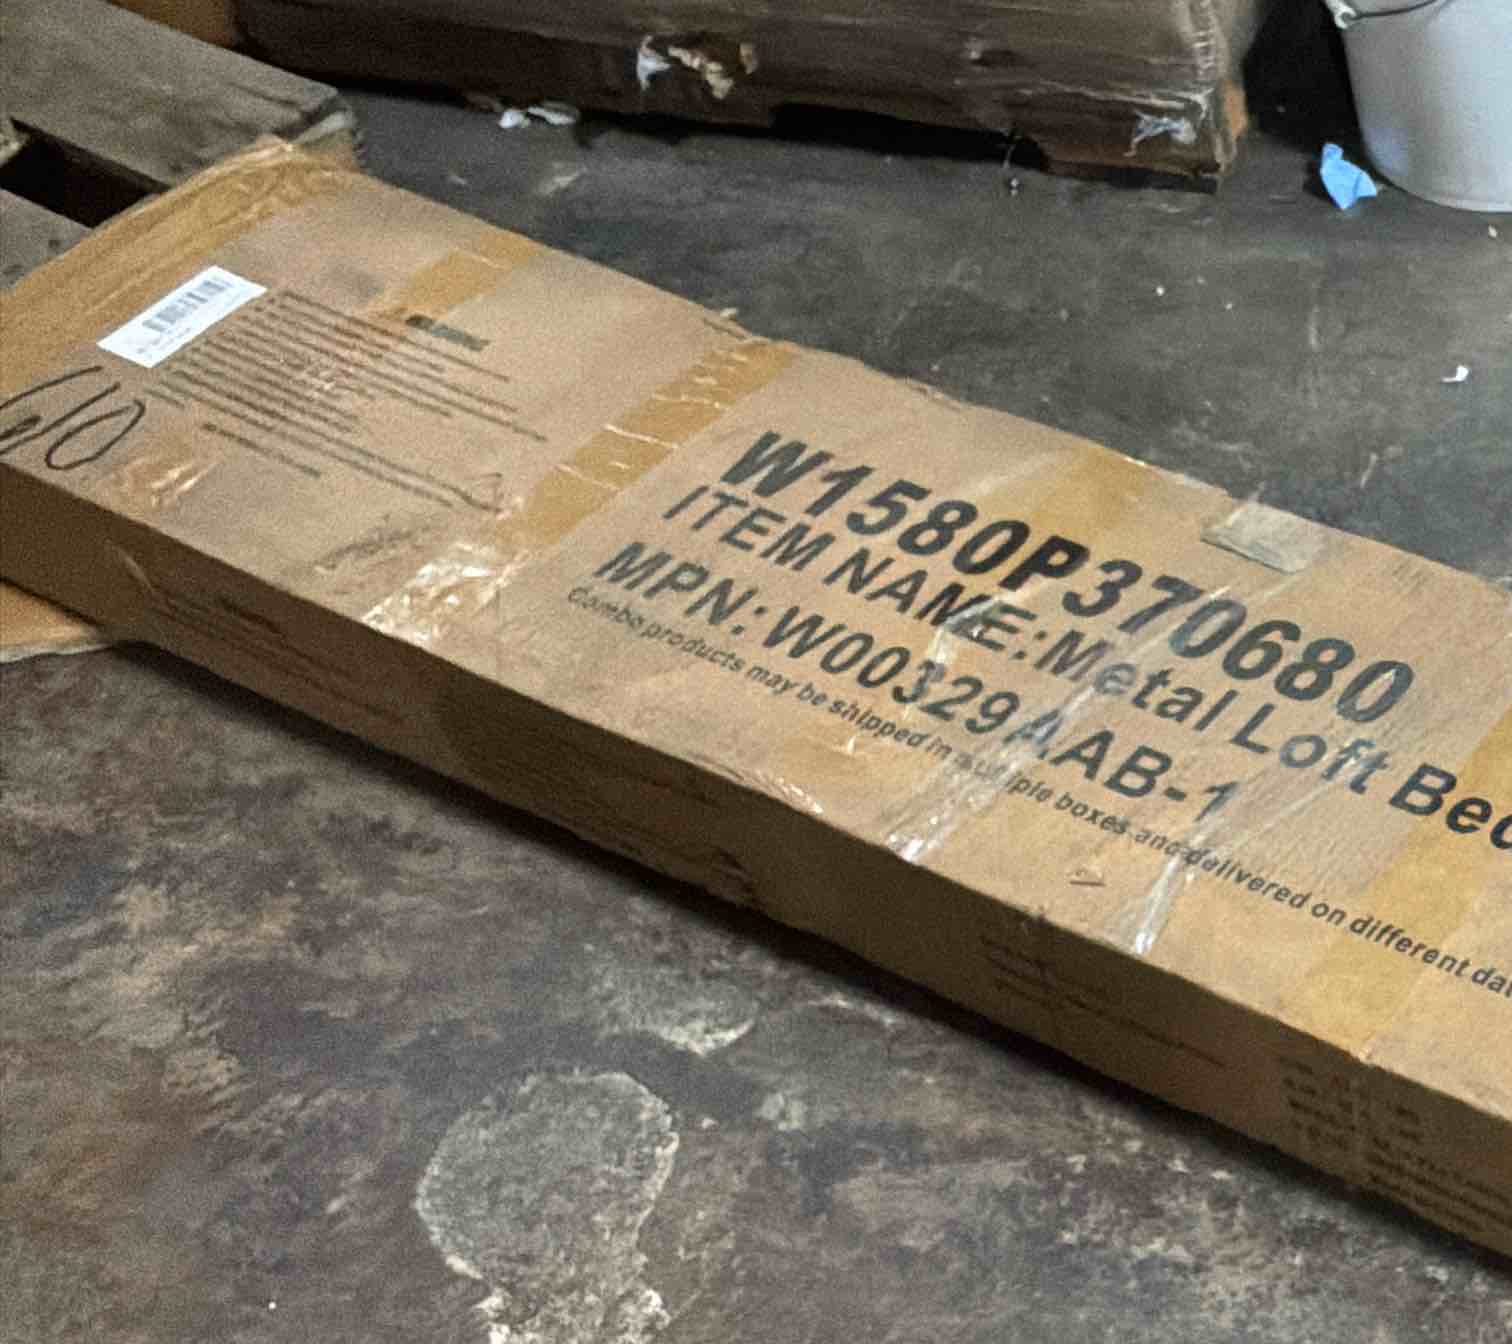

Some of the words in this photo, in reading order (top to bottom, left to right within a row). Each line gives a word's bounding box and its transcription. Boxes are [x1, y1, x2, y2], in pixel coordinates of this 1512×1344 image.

[663, 485, 836, 571] ITEM
[1230, 702, 1389, 795] Loft
[721, 431, 1414, 722] W1580P370680
[567, 586, 644, 630] Combo
[640, 621, 746, 674] products
[744, 664, 799, 698] may
[798, 682, 829, 710] be
[827, 699, 936, 750] shipped
[928, 735, 955, 760] in
[953, 752, 1054, 803] uliple
[1054, 790, 1130, 836] boxes
[1183, 845, 1315, 909] delivered
[1310, 895, 1349, 927] on
[1349, 914, 1473, 978] different
